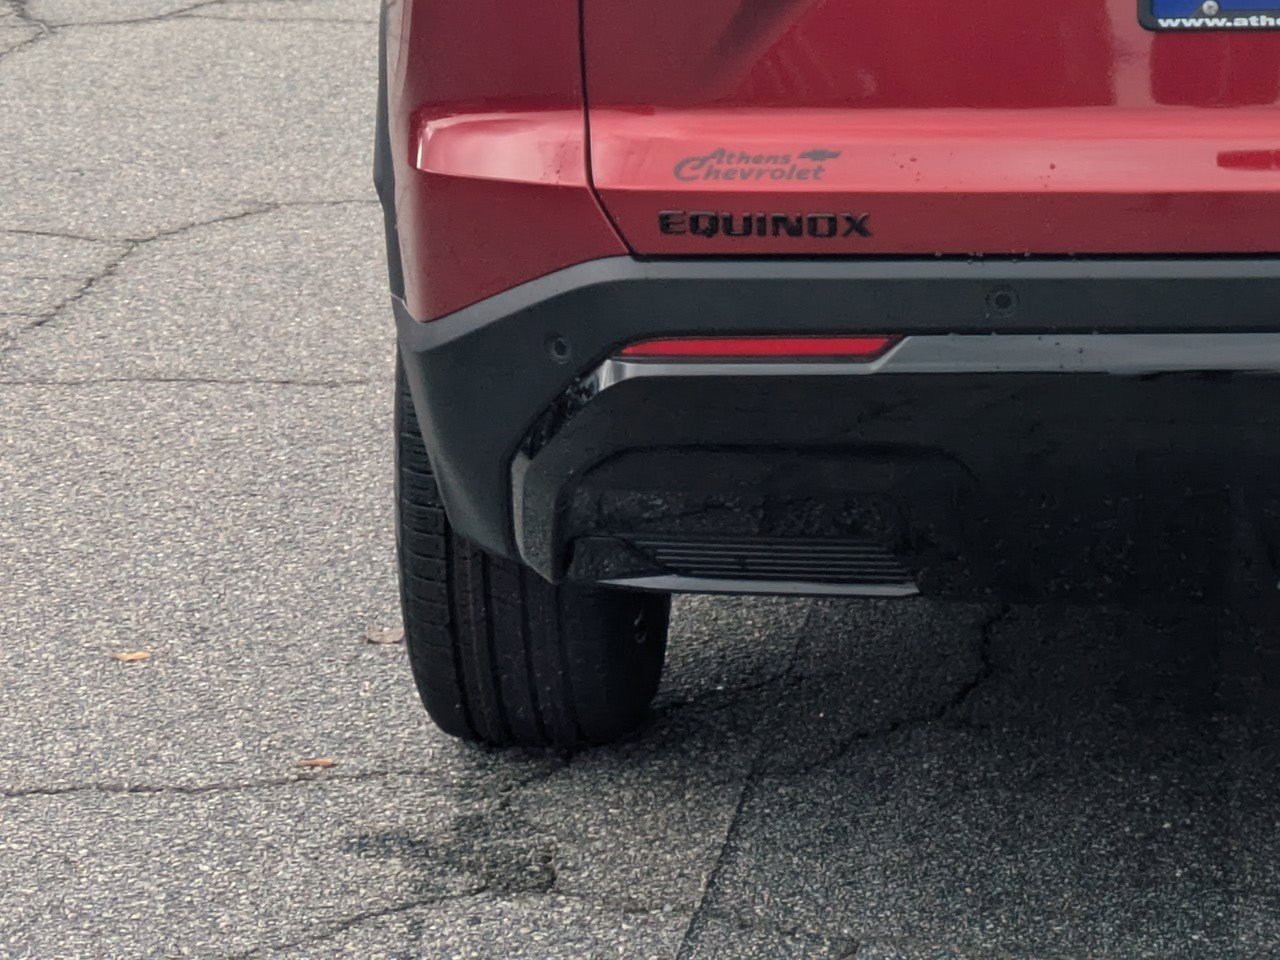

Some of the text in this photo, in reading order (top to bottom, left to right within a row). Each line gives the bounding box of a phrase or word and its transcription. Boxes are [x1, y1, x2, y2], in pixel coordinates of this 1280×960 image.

[673, 156, 826, 182] Chevrolet
[690, 148, 791, 170] Athens
[658, 210, 872, 238] EQUINOX
